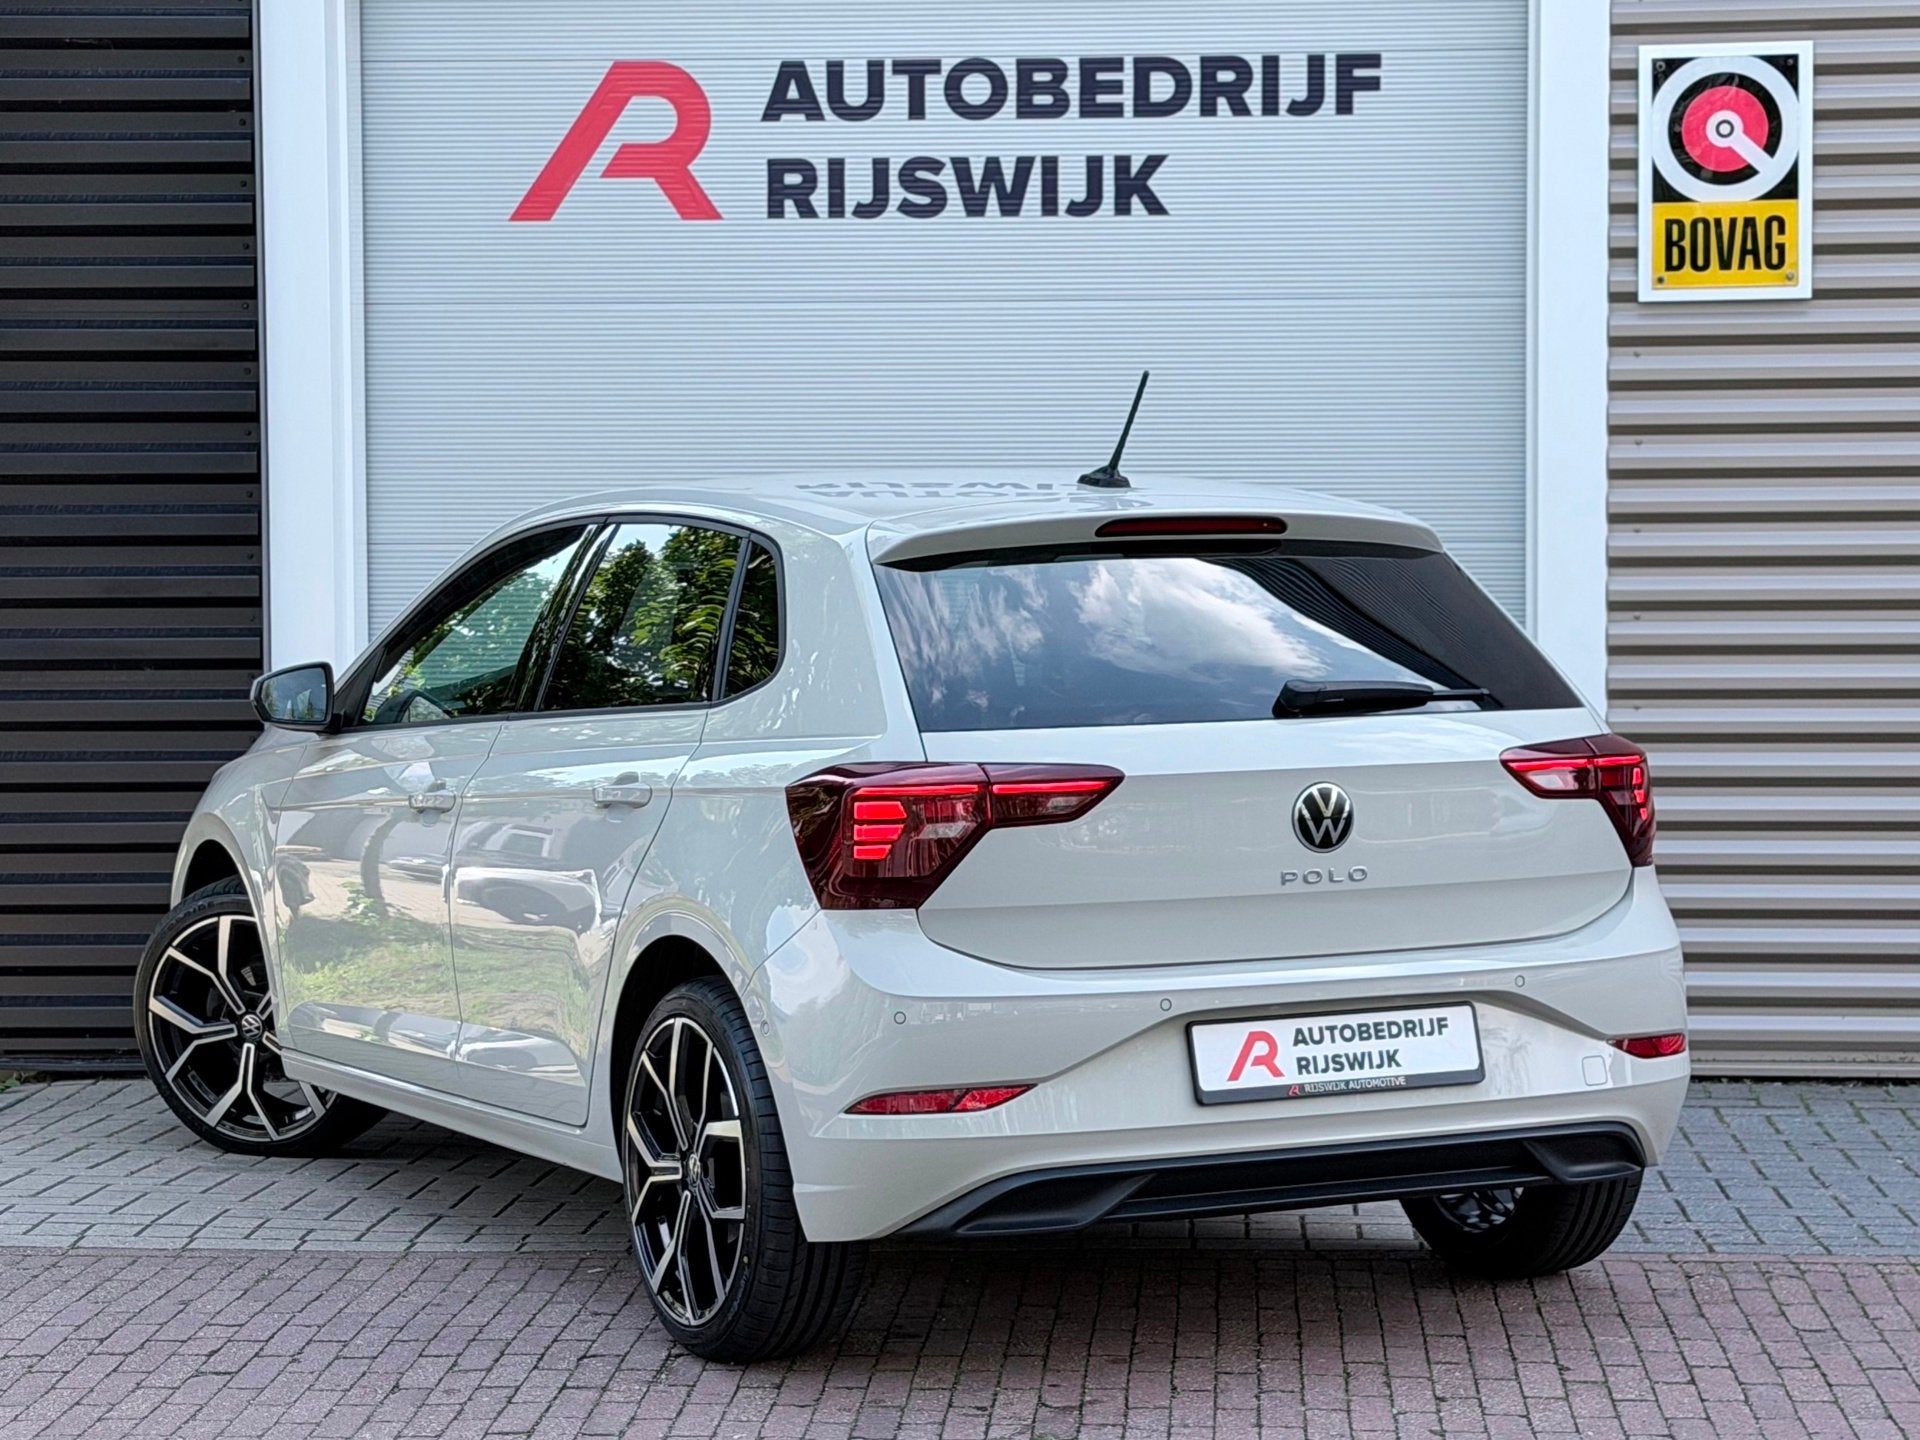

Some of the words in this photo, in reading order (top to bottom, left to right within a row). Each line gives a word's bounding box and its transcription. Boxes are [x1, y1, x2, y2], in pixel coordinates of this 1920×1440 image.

[761, 52, 1382, 122] AUTOBEDRIJF
[767, 154, 1171, 220] RIJSWIJK
[1664, 214, 1787, 273] BOVAG
[1280, 865, 1368, 886] POLO
[1292, 1016, 1449, 1047] AUTOBEDRIJF
[1296, 1049, 1403, 1076] RIJSWIJK
[1304, 1081, 1347, 1093] RIJSWIJK
[1348, 1076, 1406, 1090] AUTOMOTIVE
